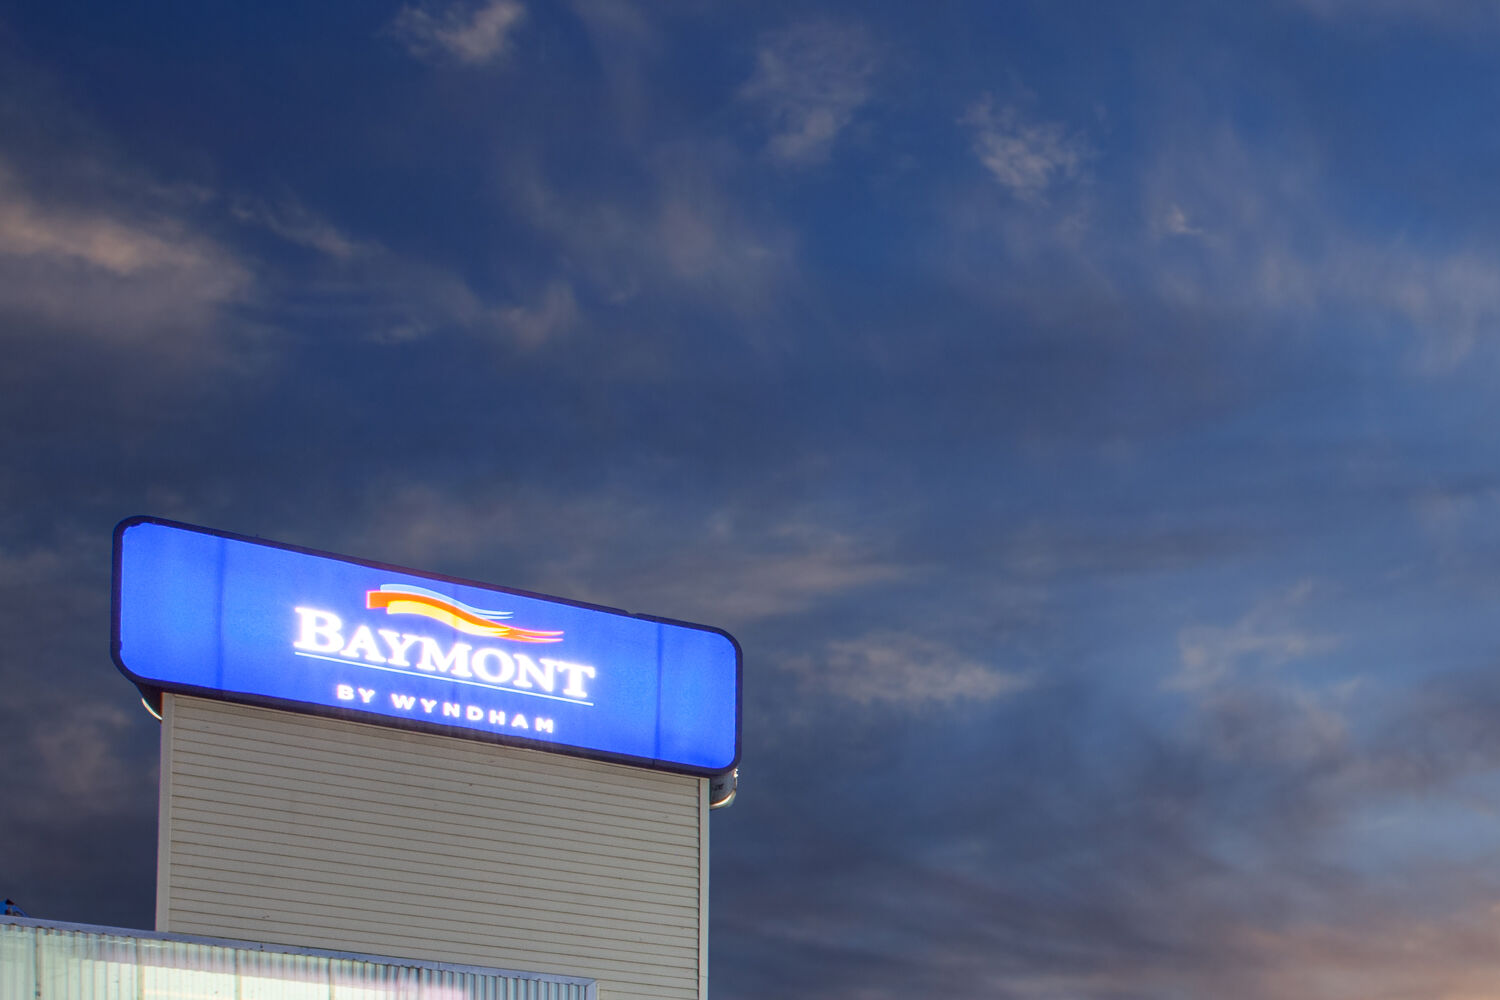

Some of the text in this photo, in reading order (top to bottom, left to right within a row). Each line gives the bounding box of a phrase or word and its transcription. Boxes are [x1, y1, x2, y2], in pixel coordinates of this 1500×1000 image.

[293, 606, 596, 698] BAYMONT
[336, 684, 555, 734] BY WYNDHAM
